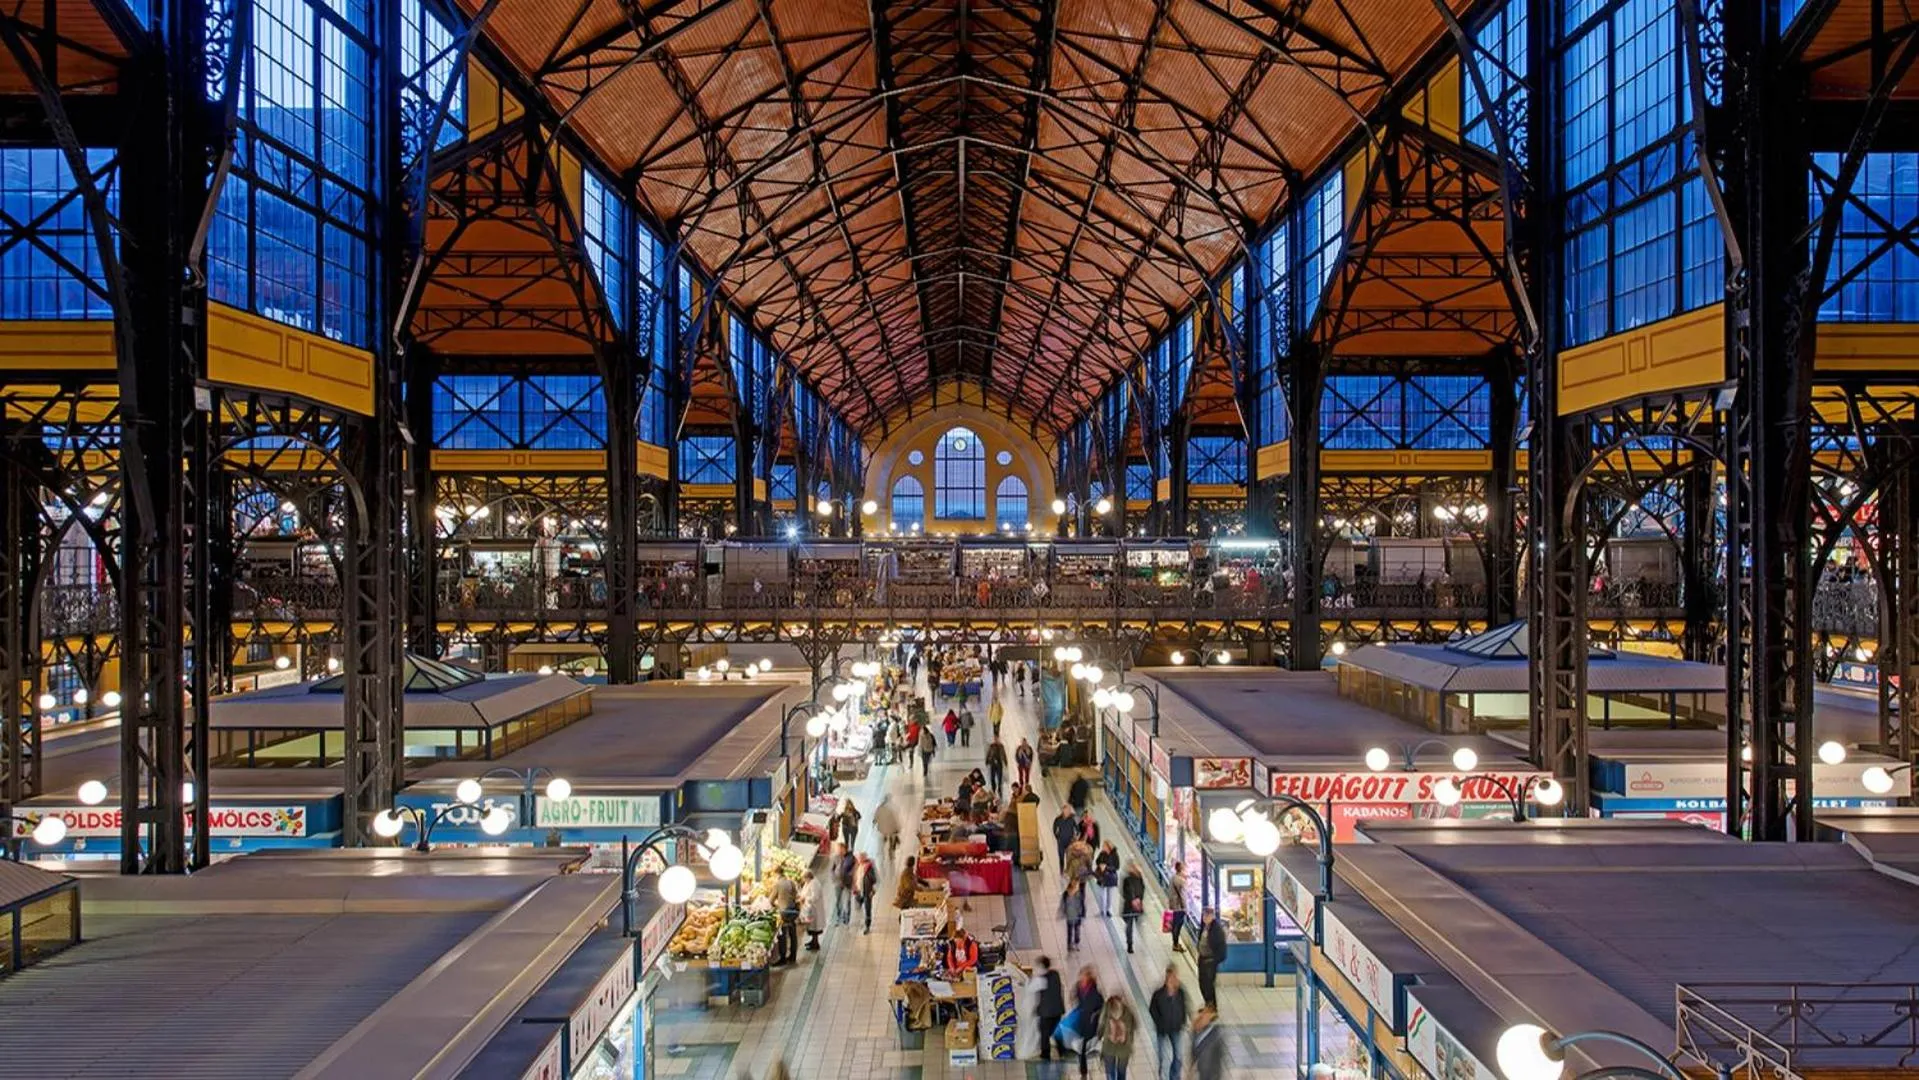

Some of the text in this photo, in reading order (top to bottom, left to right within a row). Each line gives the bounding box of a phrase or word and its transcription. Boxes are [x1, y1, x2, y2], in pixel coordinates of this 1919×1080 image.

[1274, 773, 1409, 800] FELVÁGOTT
[541, 798, 629, 823] AGRO-FRUIT
[1343, 807, 1408, 817] KABANOS
